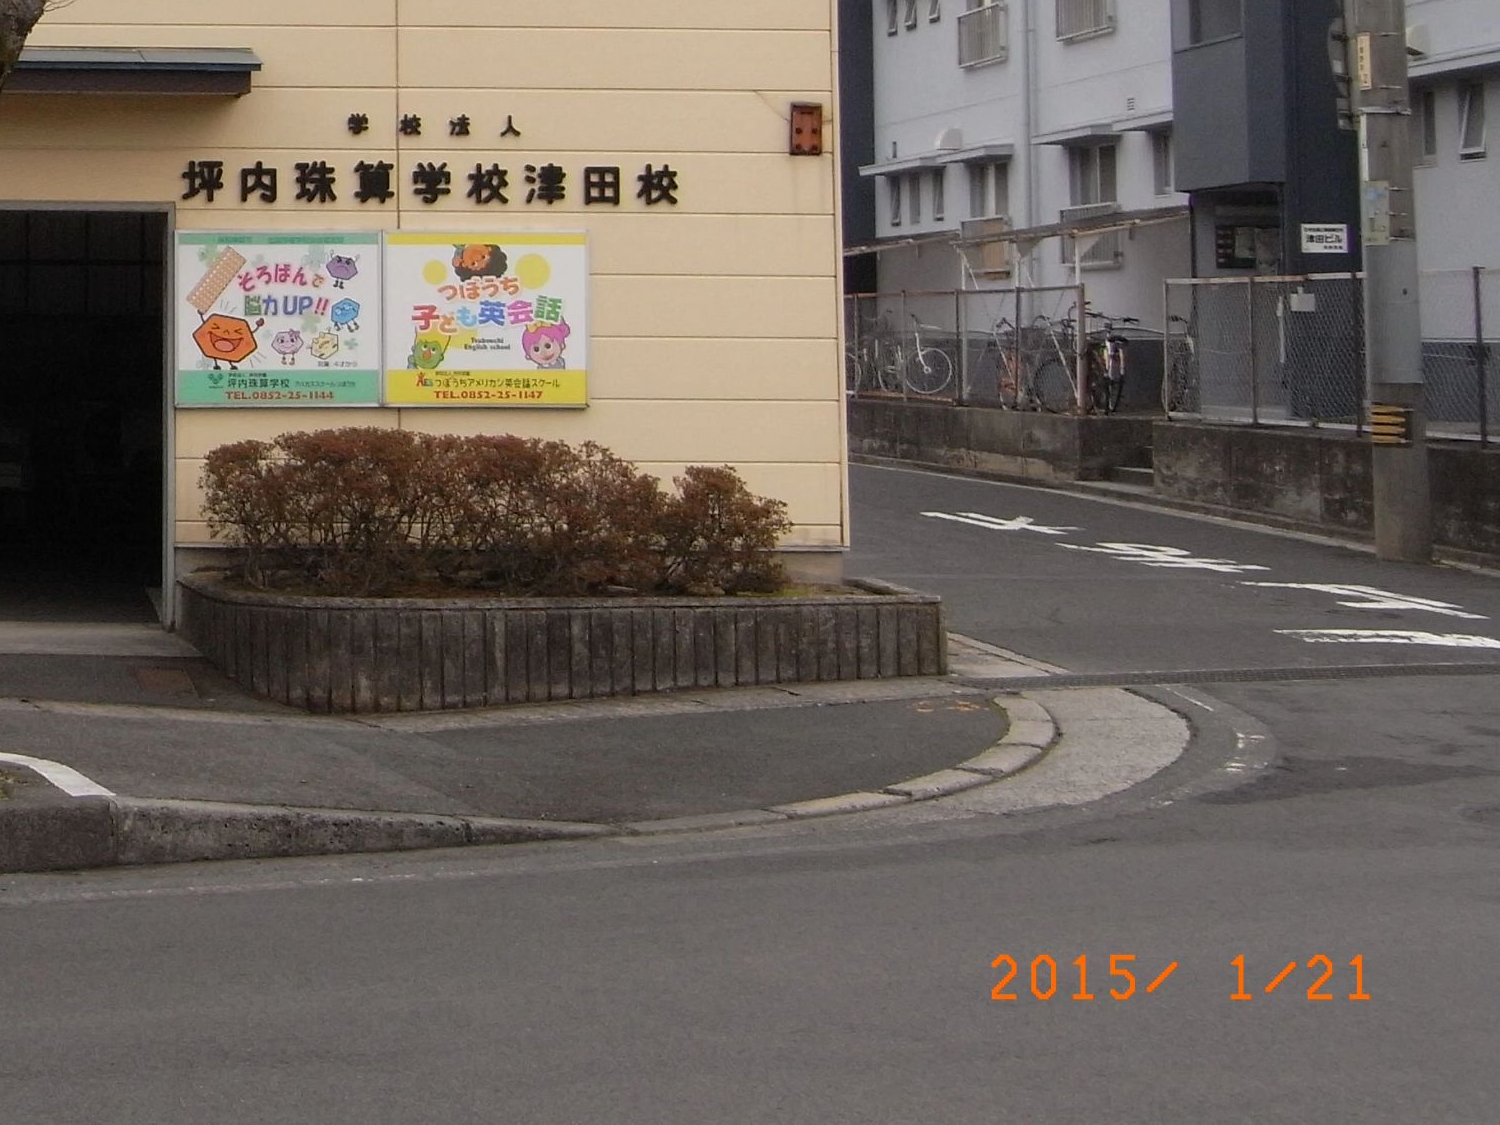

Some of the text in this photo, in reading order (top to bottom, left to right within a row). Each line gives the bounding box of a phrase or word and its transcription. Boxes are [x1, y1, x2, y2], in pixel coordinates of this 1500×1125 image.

[348, 113, 521, 137] 学校法人
[181, 159, 679, 206] 坪内珠算学校津田校
[237, 263, 325, 293] そろばんで
[437, 276, 520, 301] つぼうち
[411, 295, 563, 334] 子ども英会話
[225, 391, 334, 400] TEL.0852-25-1144
[434, 390, 543, 399] TEL.0852-25-1147
